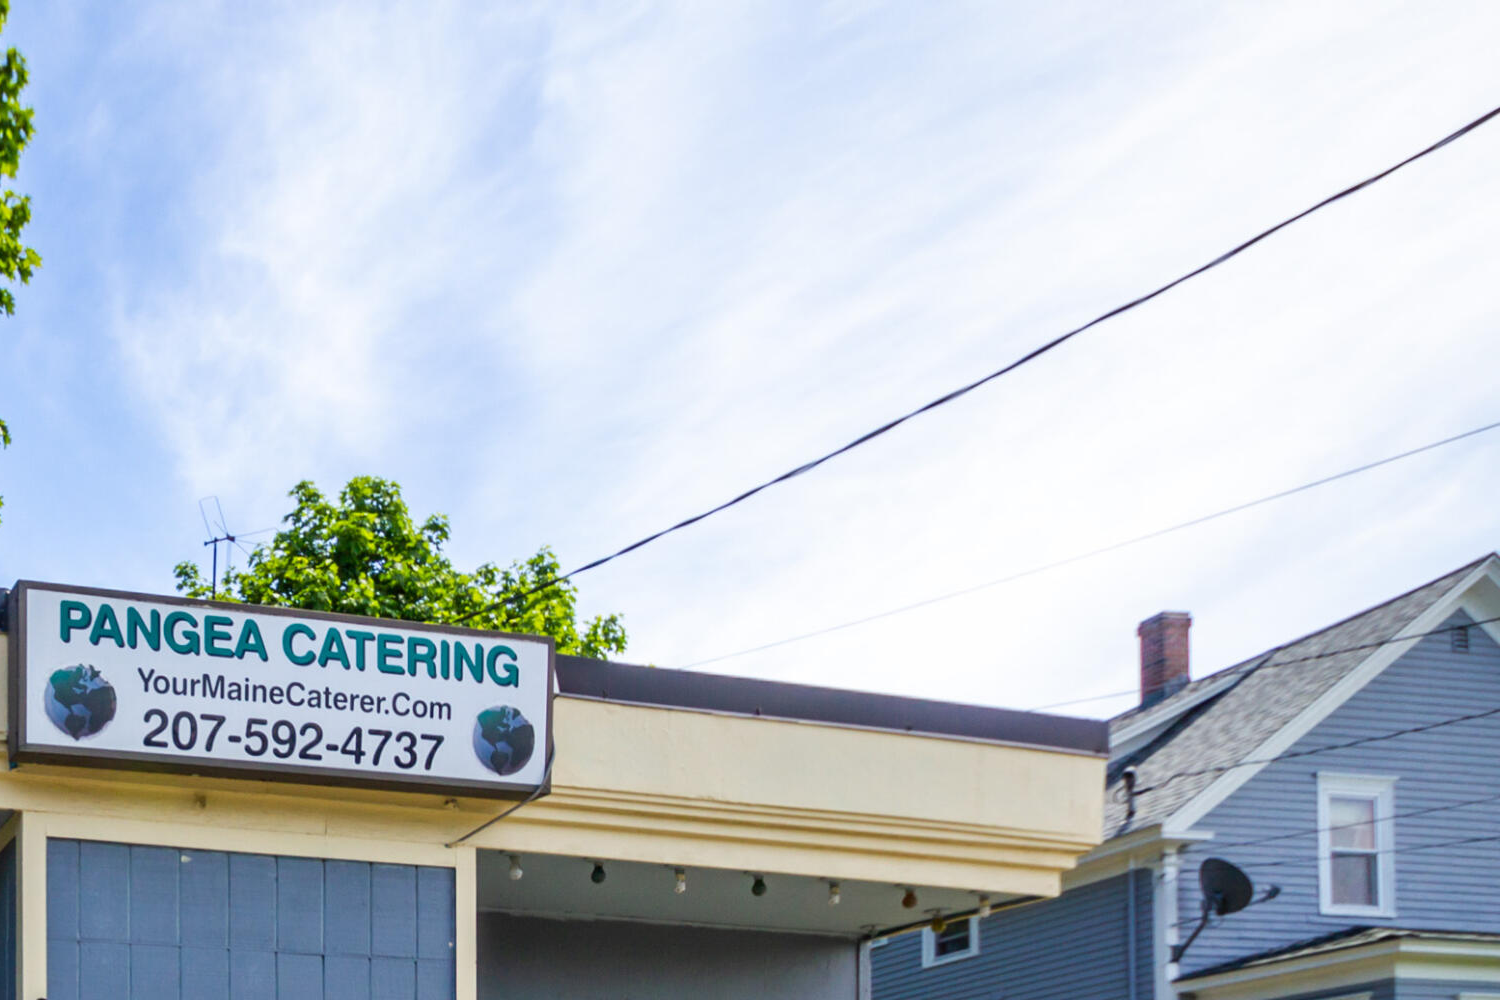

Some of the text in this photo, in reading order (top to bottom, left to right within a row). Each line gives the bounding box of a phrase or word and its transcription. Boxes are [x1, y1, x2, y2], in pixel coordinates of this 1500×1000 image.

[60, 600, 519, 688] PANGEA CATERING
[137, 667, 452, 720] YourMaineCaterer.Com
[143, 709, 445, 770] 207-592-4737
